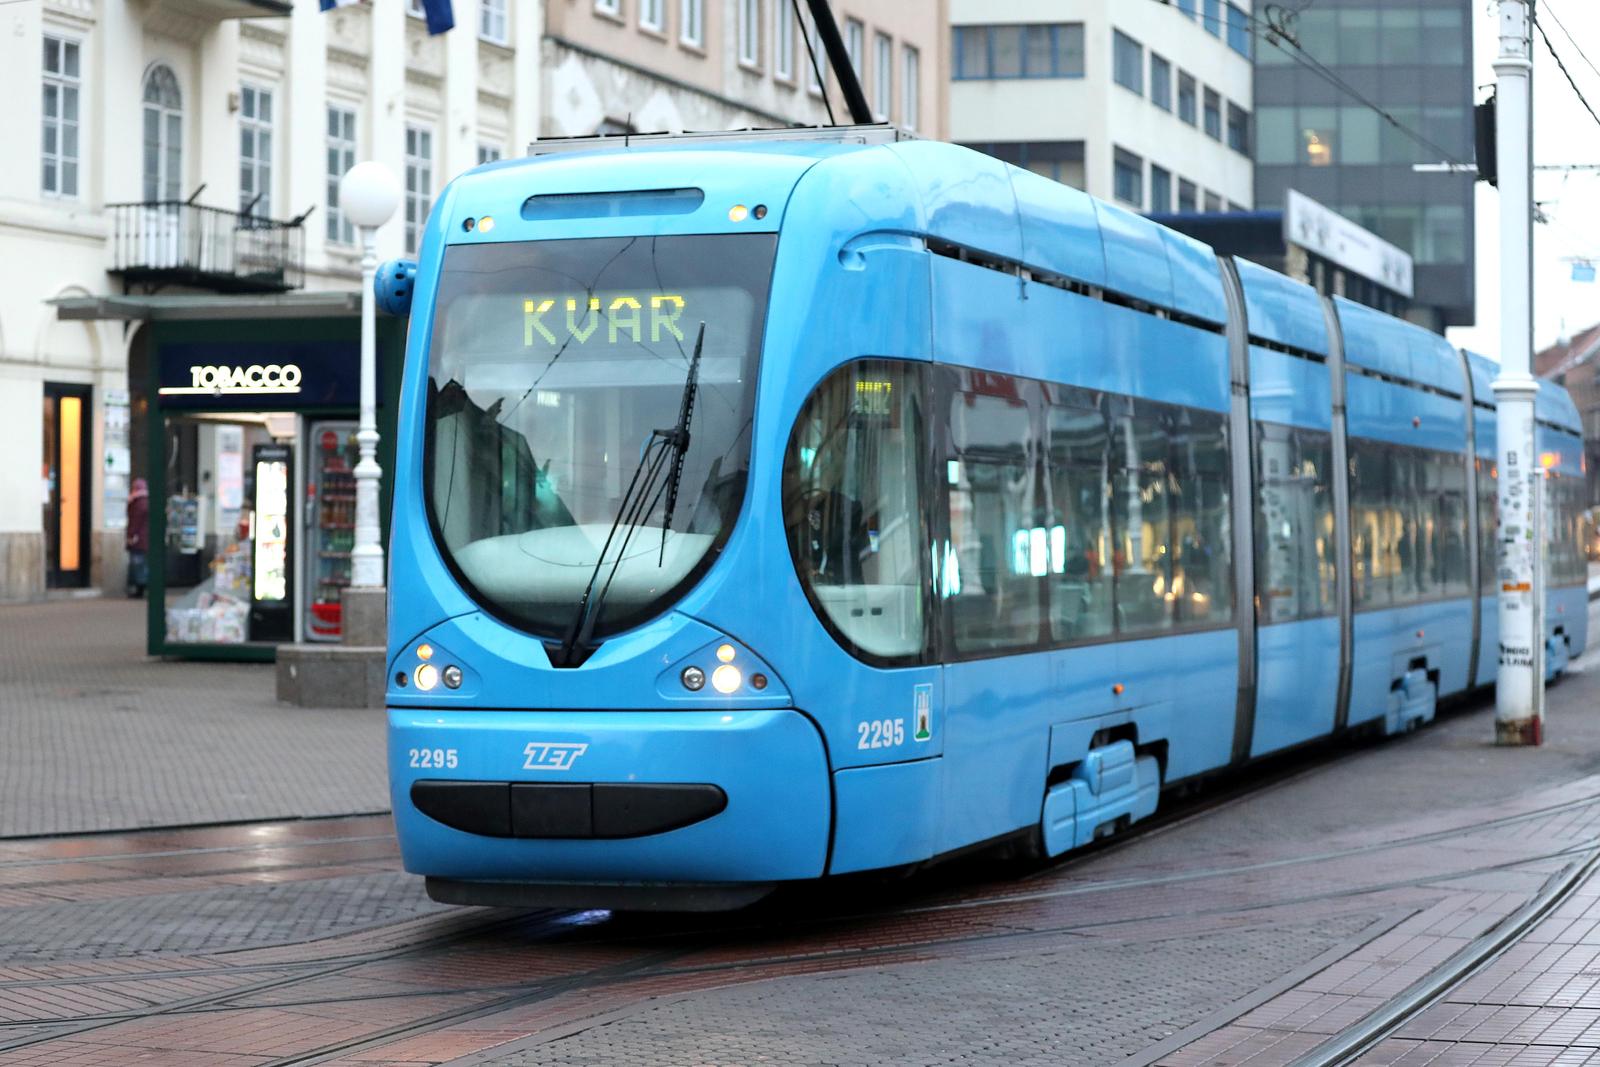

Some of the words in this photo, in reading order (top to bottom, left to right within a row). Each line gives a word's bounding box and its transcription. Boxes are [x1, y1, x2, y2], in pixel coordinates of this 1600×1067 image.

[524, 295, 685, 346] KVAR
[190, 364, 302, 387] TOBACCO
[857, 718, 904, 750] 2295
[409, 748, 459, 769] 2295
[522, 742, 589, 770] ZET
